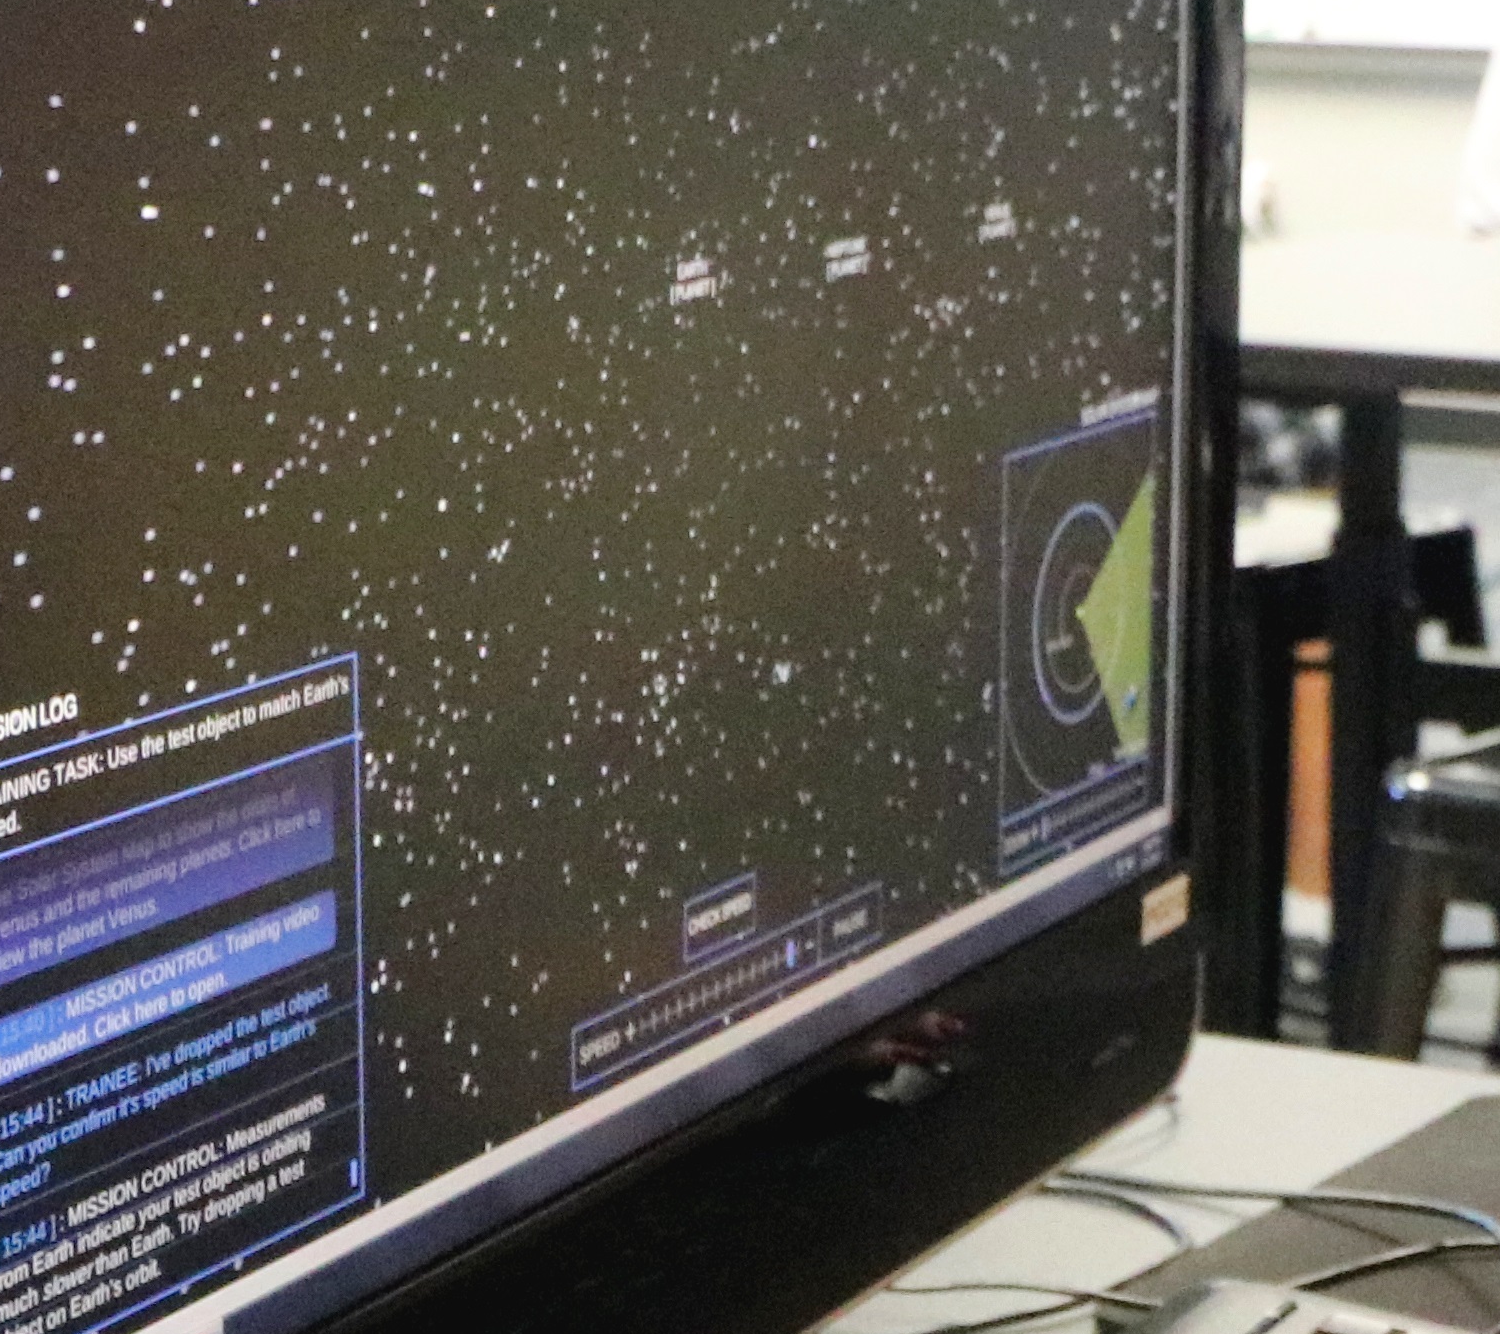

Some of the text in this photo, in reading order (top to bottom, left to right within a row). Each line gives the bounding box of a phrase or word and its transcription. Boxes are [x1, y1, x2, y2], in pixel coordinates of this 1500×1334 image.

[38, 693, 79, 727] LOG
[53, 755, 106, 788] TASK:
[107, 745, 139, 771] Use
[141, 734, 166, 759] the
[167, 726, 196, 751] test
[198, 713, 241, 745] object
[243, 707, 257, 725] to
[259, 694, 301, 721] match
[303, 674, 350, 705] Earth's
[42, 898, 74, 925] and
[75, 888, 101, 913] the
[103, 860, 178, 901] remaining
[27, 932, 54, 960] the
[56, 918, 107, 956] planet
[65, 977, 138, 1017] MISSION
[225, 920, 281, 956] Training
[283, 903, 321, 932] video
[94, 1008, 131, 1039] Click
[132, 995, 169, 1024] here
[170, 988, 186, 1008] to
[187, 970, 229, 1005] open.
[144, 1050, 172, 1078] I've
[173, 1019, 234, 1067] dropped
[235, 1013, 258, 1038] the
[259, 1005, 286, 1029] test
[578, 1030, 622, 1067] SPEED
[26, 1134, 58, 1166] you
[60, 1108, 118, 1145] confirm
[118, 1091, 141, 1116] it's
[142, 1070, 190, 1110] speed
[190, 1066, 204, 1085] is
[205, 1044, 251, 1079] similar
[252, 1040, 268, 1060] to
[269, 1018, 318, 1053] Earth's
[1, 1092, 327, 1261] 15:44 MISSION CONTROL: Measurements
[31, 1242, 74, 1277] Earth
[76, 1213, 136, 1254] indicate
[137, 1198, 173, 1230] your
[173, 1184, 201, 1209] test
[201, 1163, 246, 1202] object
[246, 1153, 260, 1172] is
[260, 1128, 312, 1167] orbiting
[42, 1264, 95, 1303] slower
[94, 1248, 129, 1283] than
[131, 1223, 176, 1257] Earth.
[177, 1209, 202, 1237] Try
[203, 1178, 267, 1224] dropping
[278, 1157, 307, 1183] test
[45, 1307, 68, 1331] on
[69, 1276, 123, 1320] Earth's
[124, 1258, 163, 1291] orbit.
